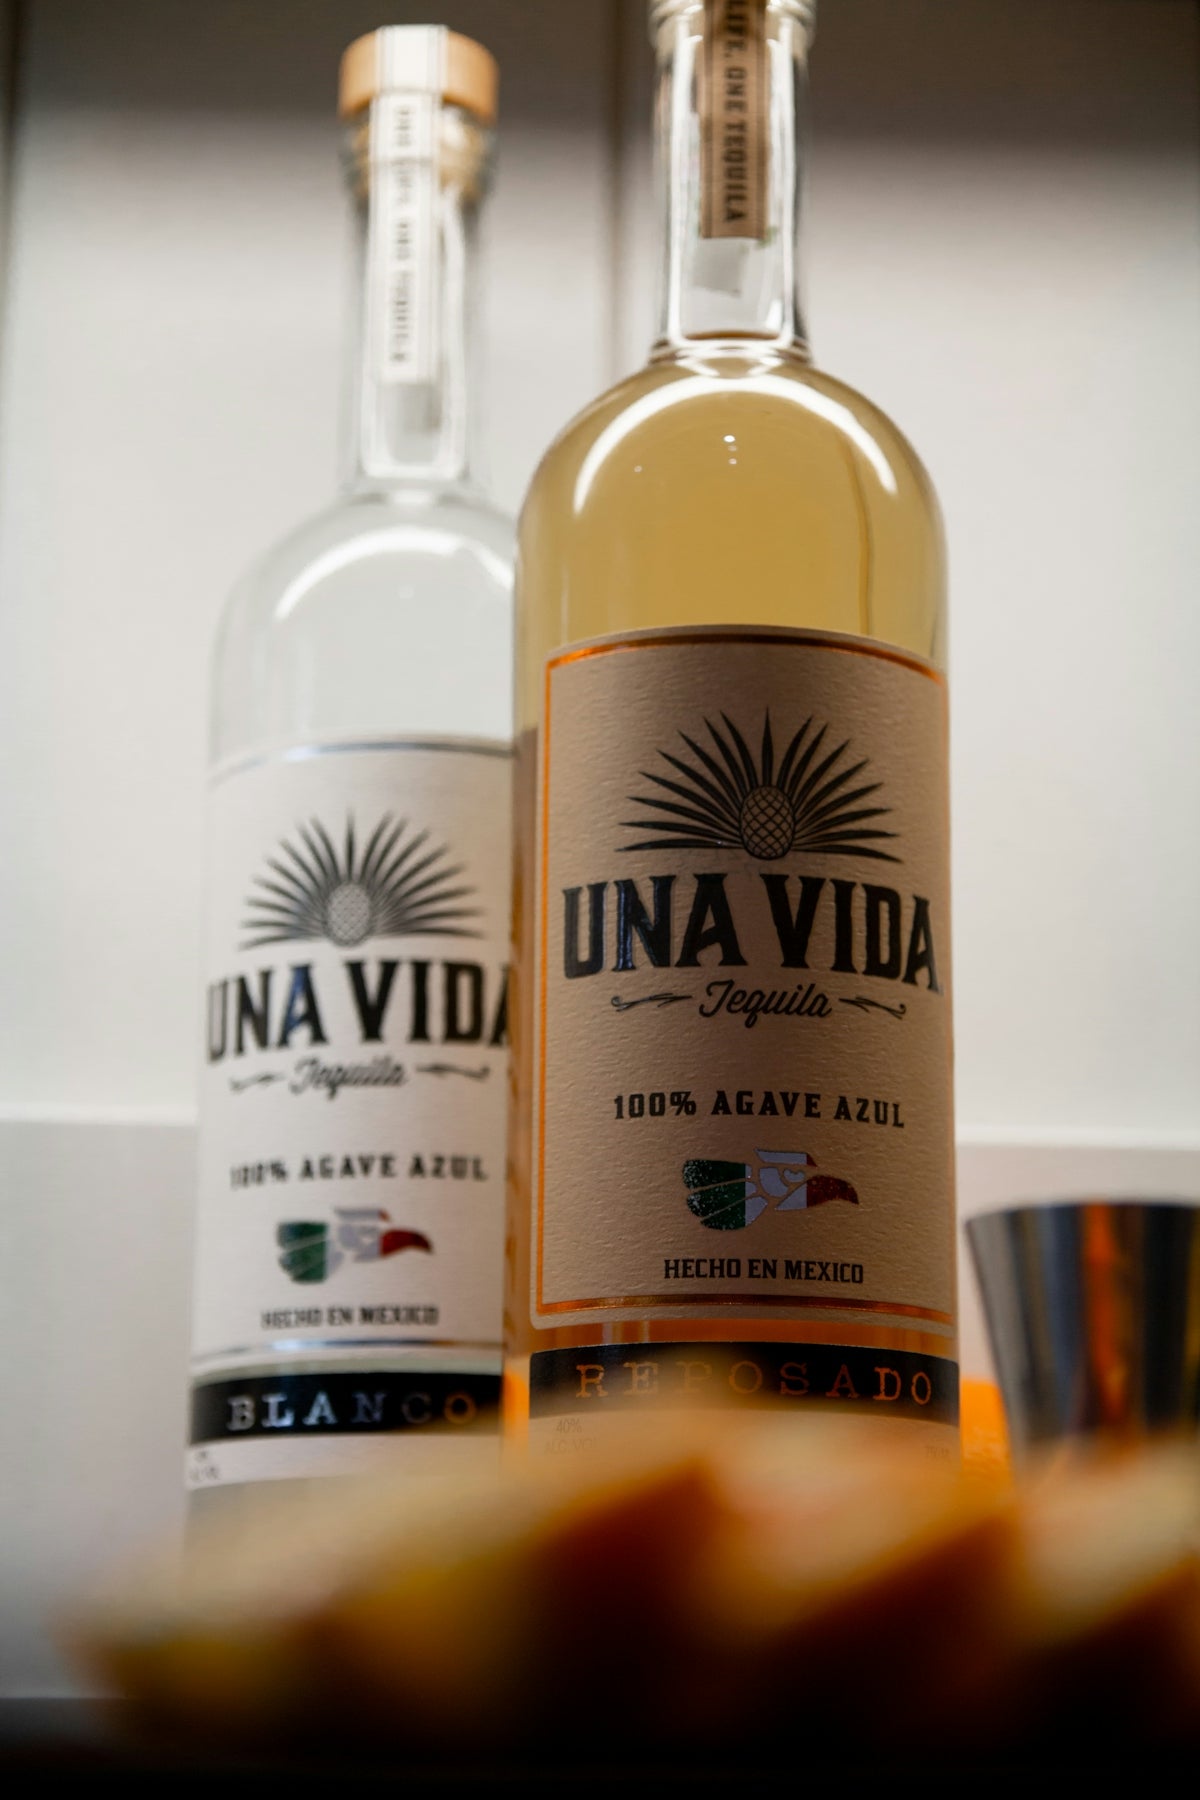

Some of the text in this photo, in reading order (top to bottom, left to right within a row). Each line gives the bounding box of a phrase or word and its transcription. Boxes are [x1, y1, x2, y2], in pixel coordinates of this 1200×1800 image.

[725, 66, 747, 113] ONE
[724, 121, 748, 224] TEQUILA
[562, 873, 943, 994] UNA VIDA
[206, 961, 328, 1066] UNA
[699, 979, 833, 1029] Tequila
[288, 1054, 408, 1101] Tequila
[614, 1090, 905, 1129] 100% AGAVE AZUL
[298, 1153, 397, 1179] AGAVE
[408, 1154, 489, 1182] AZUL
[664, 1258, 864, 1284] HECHO EN MEXICO
[261, 1306, 440, 1330] HECHO EN MEXICO
[575, 1360, 932, 1406] REPOSADO
[226, 1391, 477, 1431] BLANCO
